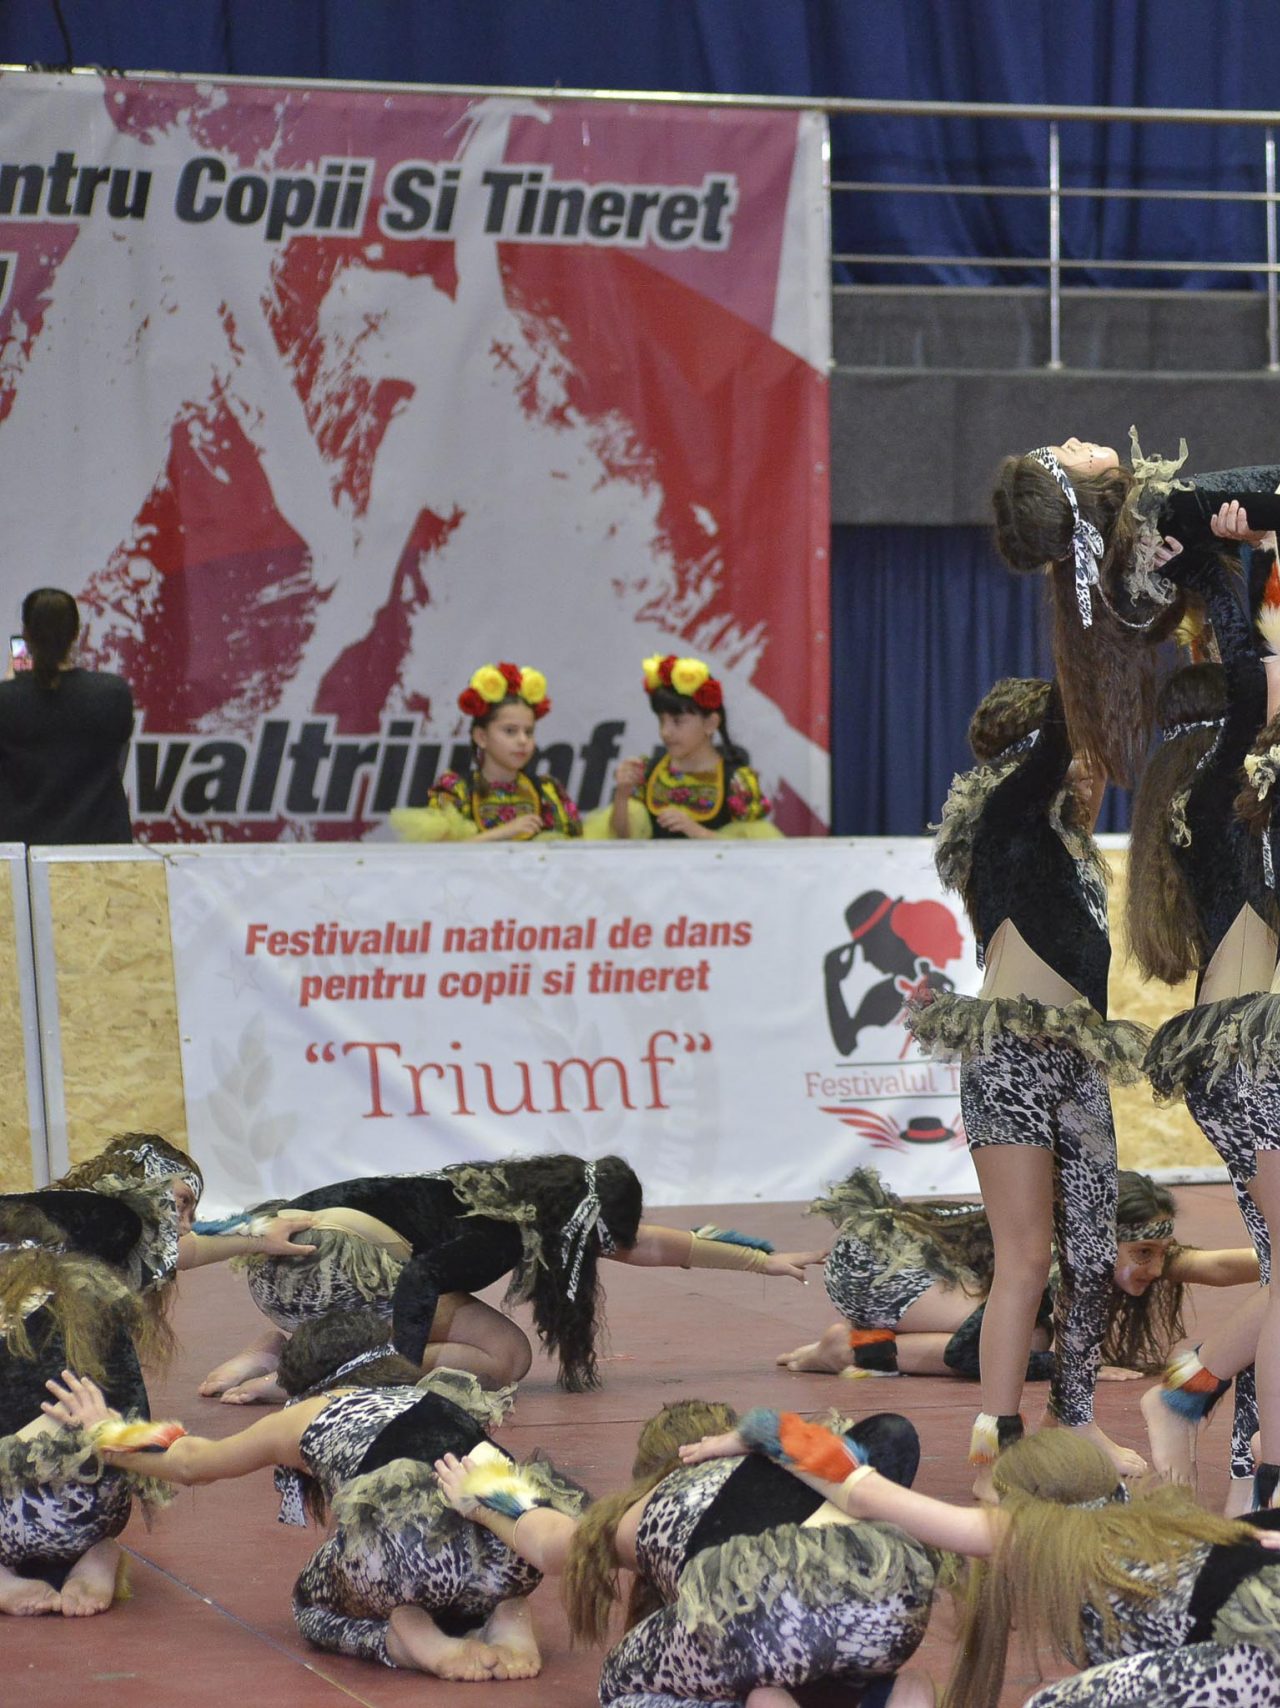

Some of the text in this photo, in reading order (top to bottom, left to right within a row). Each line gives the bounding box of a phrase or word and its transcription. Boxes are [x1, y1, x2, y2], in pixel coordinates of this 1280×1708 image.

[176, 157, 366, 242] Copii
[386, 168, 461, 233] Si
[482, 171, 733, 243] Tineret
[245, 915, 753, 956] Festivalul national de dans
[300, 959, 710, 1007] pentru copii si tineret
[805, 1064, 937, 1098] Festivalul
